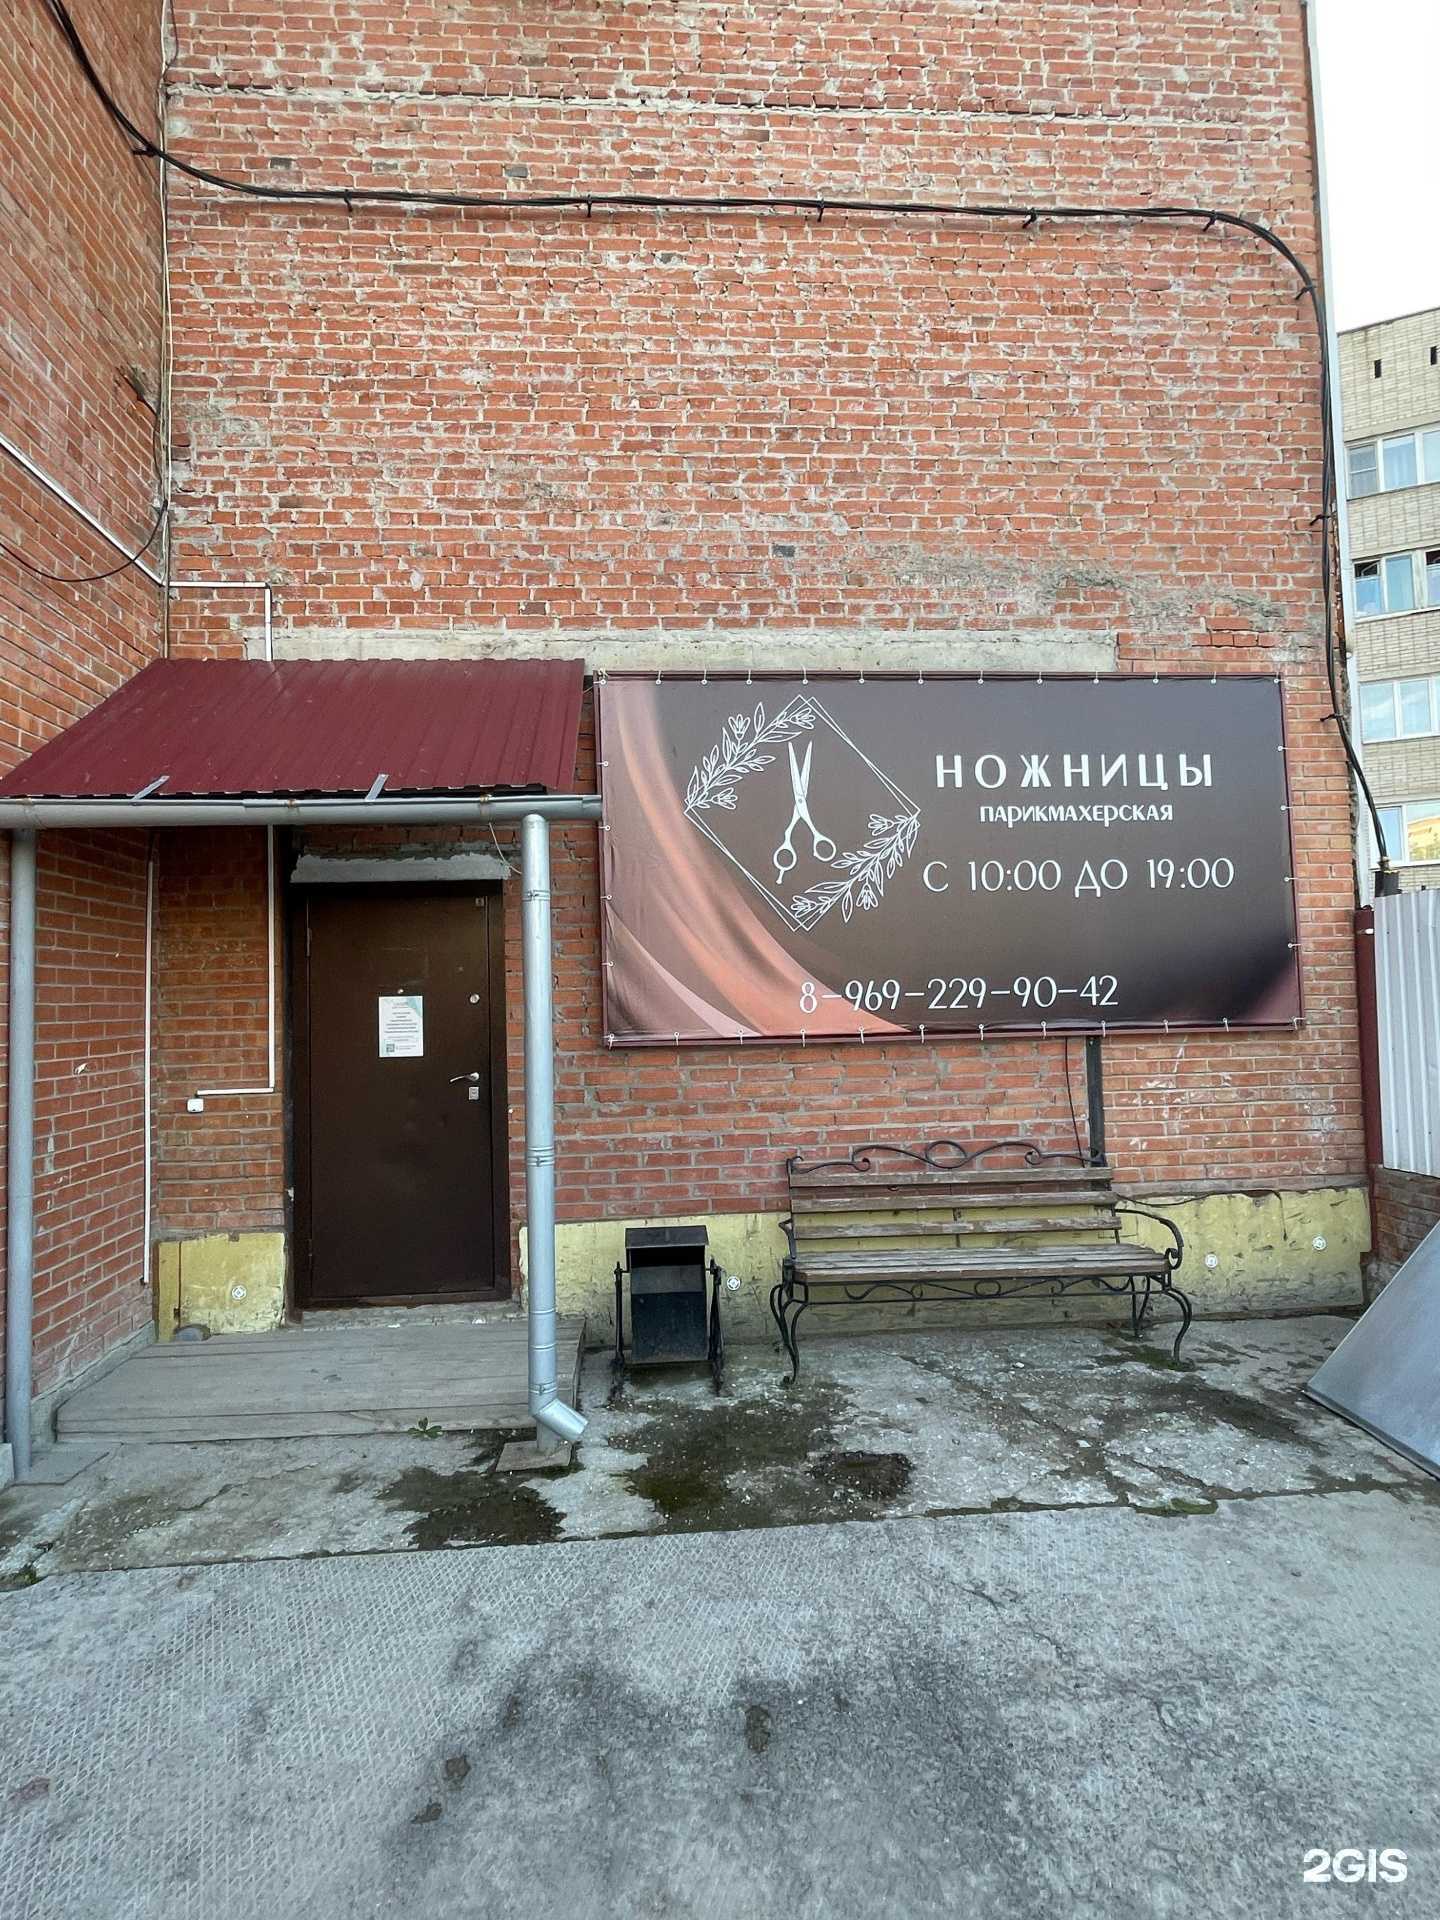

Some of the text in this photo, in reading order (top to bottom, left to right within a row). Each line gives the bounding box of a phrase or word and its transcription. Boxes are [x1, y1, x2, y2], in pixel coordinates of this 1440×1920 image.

[935, 753, 1213, 791] НОЖНИЦЫ
[979, 803, 1174, 828] ПАРИКМАХЕРСКАЯ
[922, 857, 1235, 898] С 10:00 ДО 19:00
[799, 975, 1119, 1014] 8-969-229-90-42
